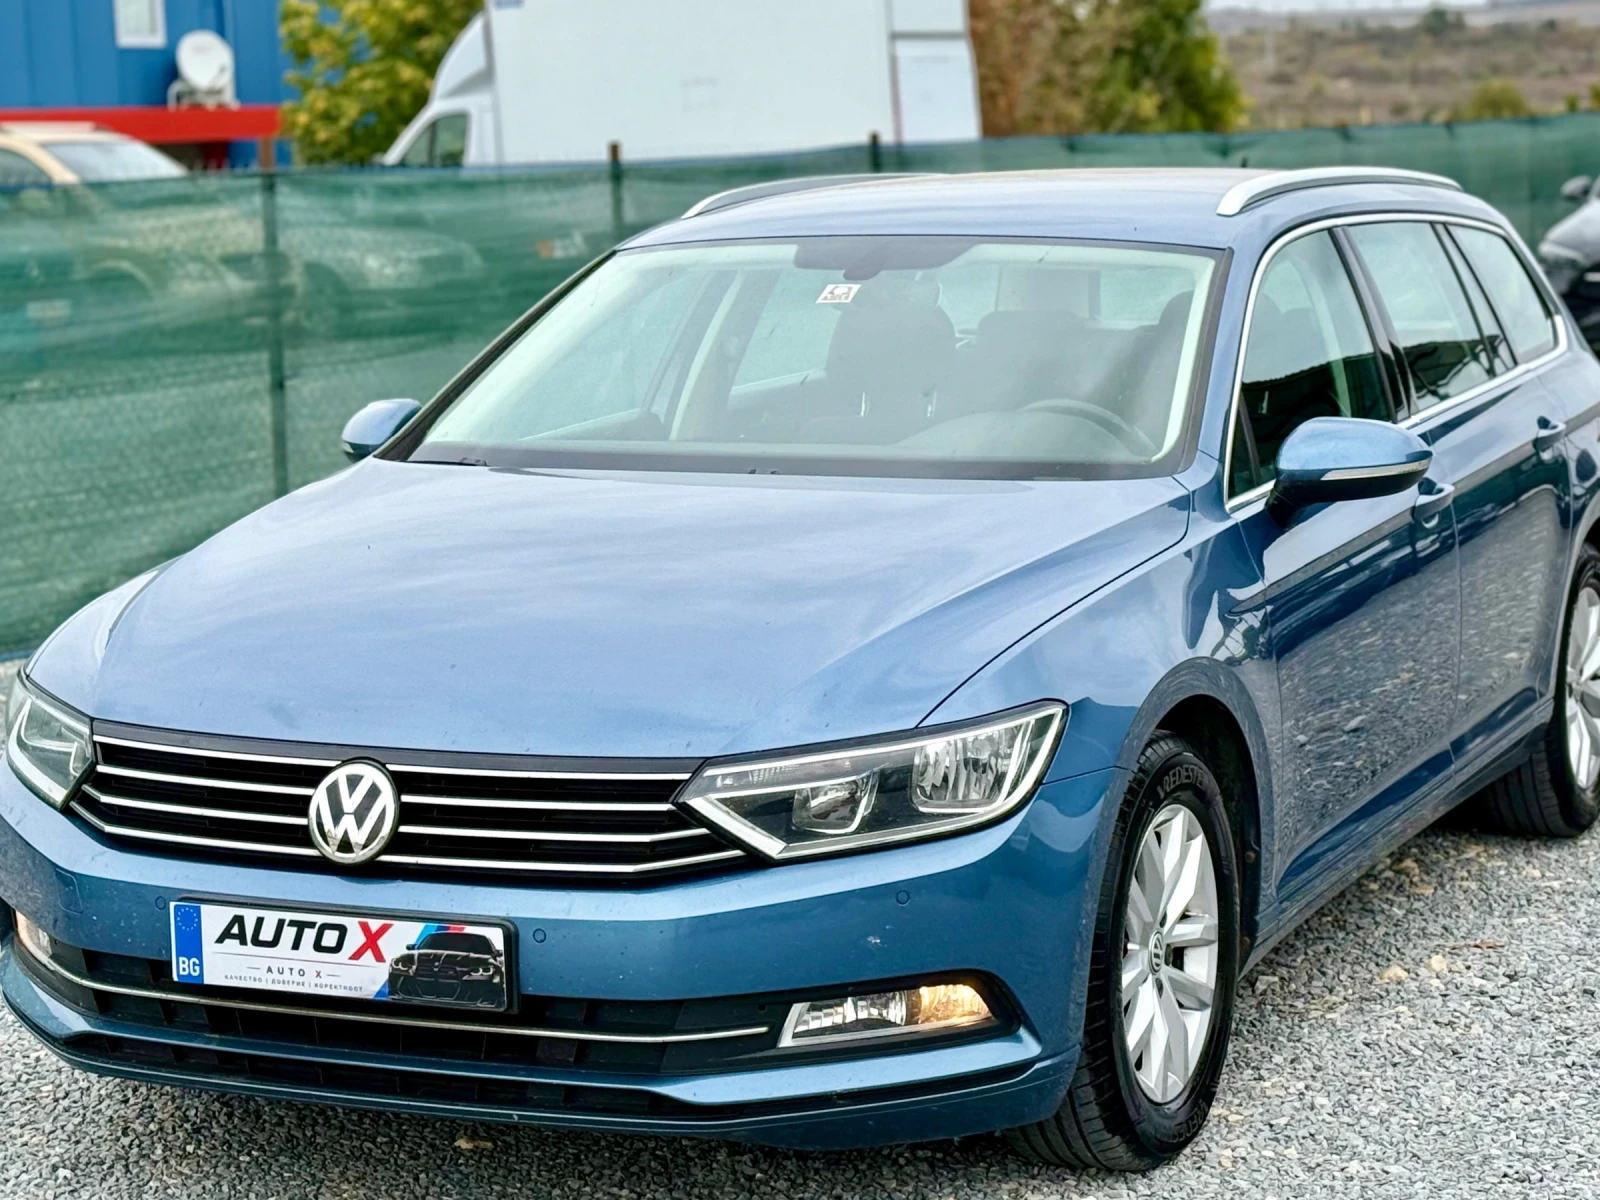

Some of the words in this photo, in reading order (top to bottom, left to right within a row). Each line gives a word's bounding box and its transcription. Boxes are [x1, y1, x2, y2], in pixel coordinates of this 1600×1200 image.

[179, 957, 201, 977] BG
[266, 965, 306, 977] AUTO
[315, 970, 323, 980] X
[225, 974, 263, 984] КАЧЕСТВО
[271, 977, 305, 988] ДОВЕРИЕ
[314, 982, 363, 993] КОРЕКТНОСТ
